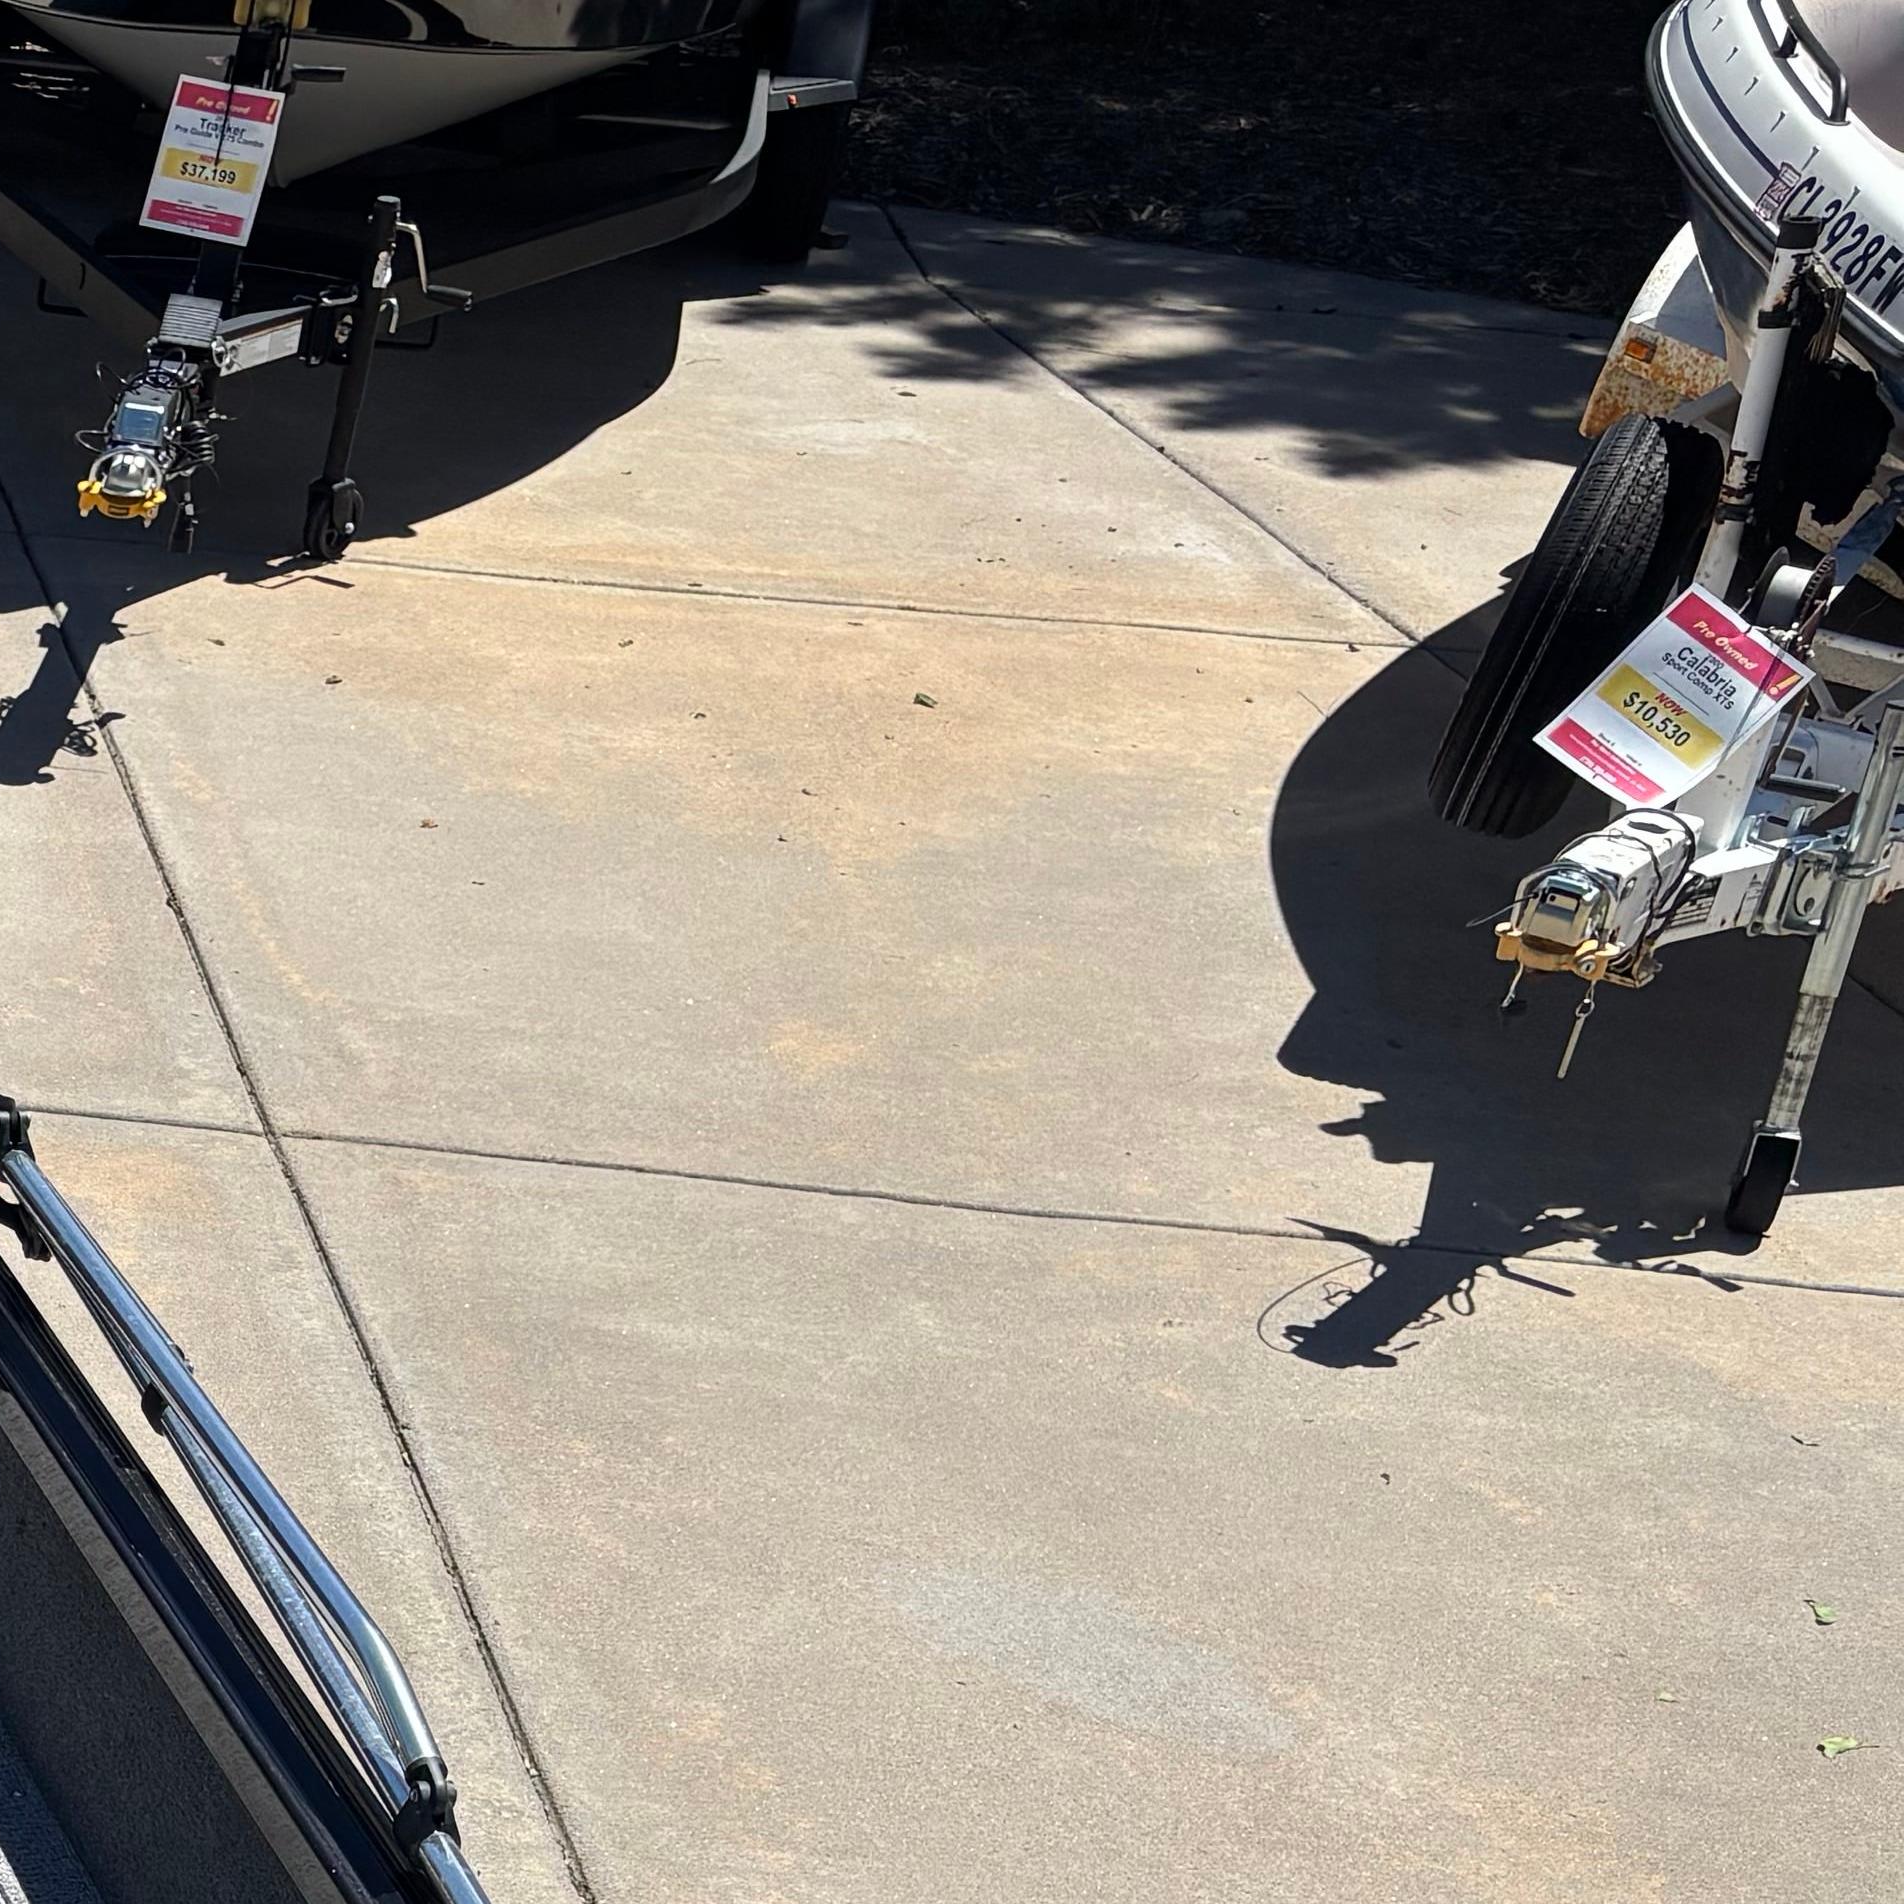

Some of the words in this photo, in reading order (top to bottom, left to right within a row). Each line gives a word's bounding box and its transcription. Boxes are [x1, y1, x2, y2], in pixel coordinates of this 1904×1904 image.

[200, 118, 247, 136] Traker
[180, 161, 236, 185] $37,199
[1693, 620, 1716, 641] Pre
[1715, 636, 1758, 671] Owned
[1662, 652, 1687, 677] Sport
[1686, 671, 1713, 695] Comp
[1712, 689, 1735, 711] XTS
[1677, 646, 1738, 698] Calabria
[1623, 691, 1691, 748] $10,530
[1655, 692, 1689, 717] NOW
